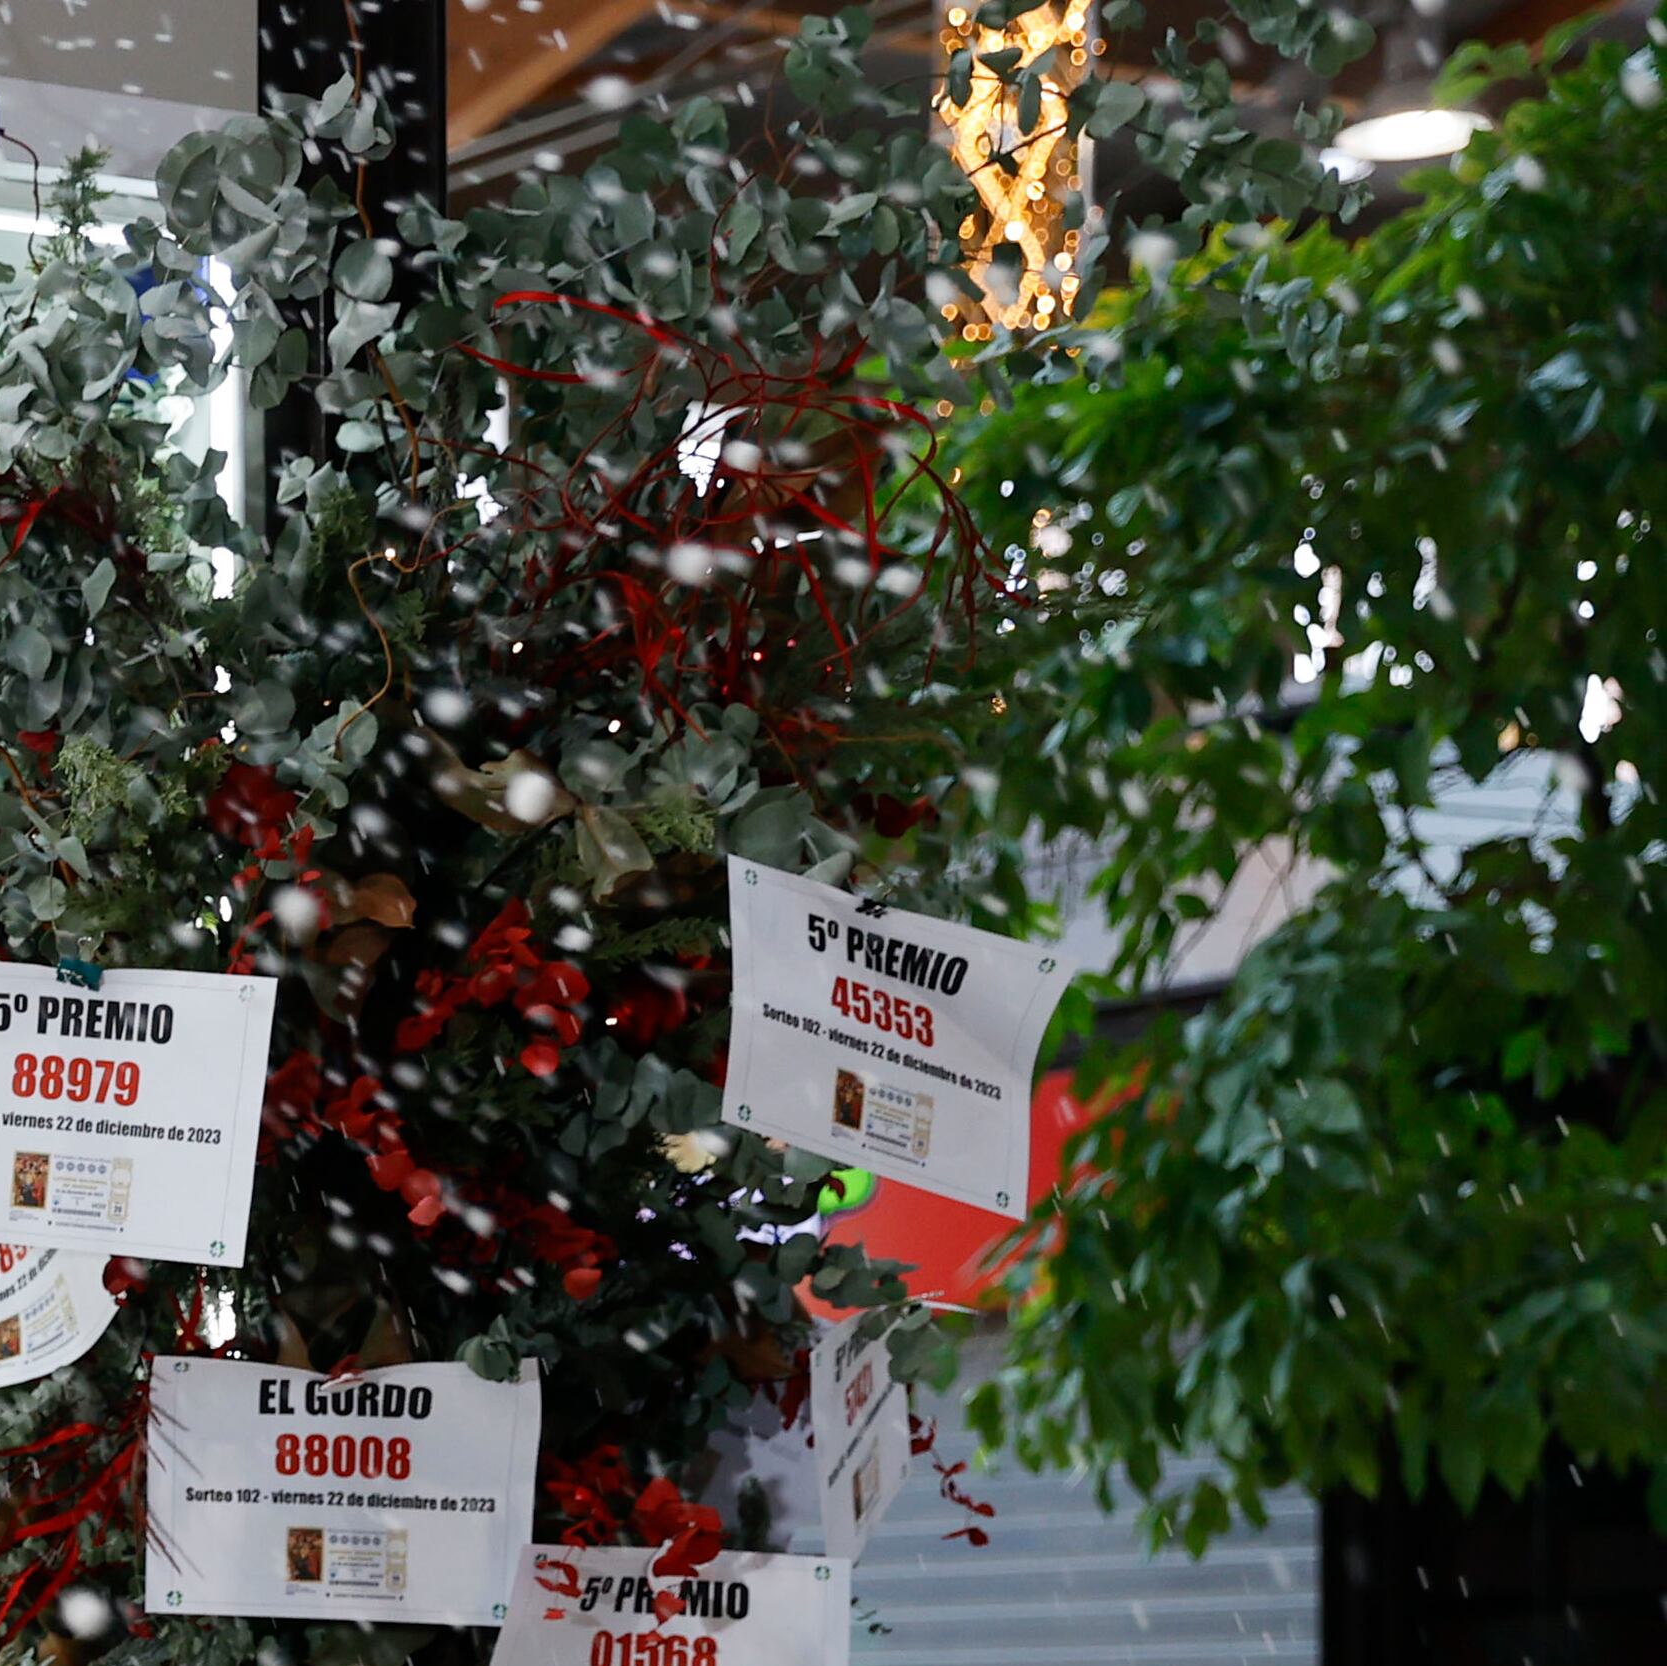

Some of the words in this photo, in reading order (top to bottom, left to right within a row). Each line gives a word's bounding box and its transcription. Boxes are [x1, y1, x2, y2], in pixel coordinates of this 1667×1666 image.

[807, 913, 840, 953] 5º
[847, 925, 969, 996] PREMIO
[37, 995, 174, 1045] PREMIO
[831, 976, 934, 1048] 45353
[11, 1052, 141, 1107] 88979
[259, 1378, 295, 1415] EL
[305, 1379, 433, 1420] GORDO
[275, 1433, 411, 1481] 88008
[580, 1576, 614, 1612] 5º
[614, 1576, 750, 1620] PRMIO
